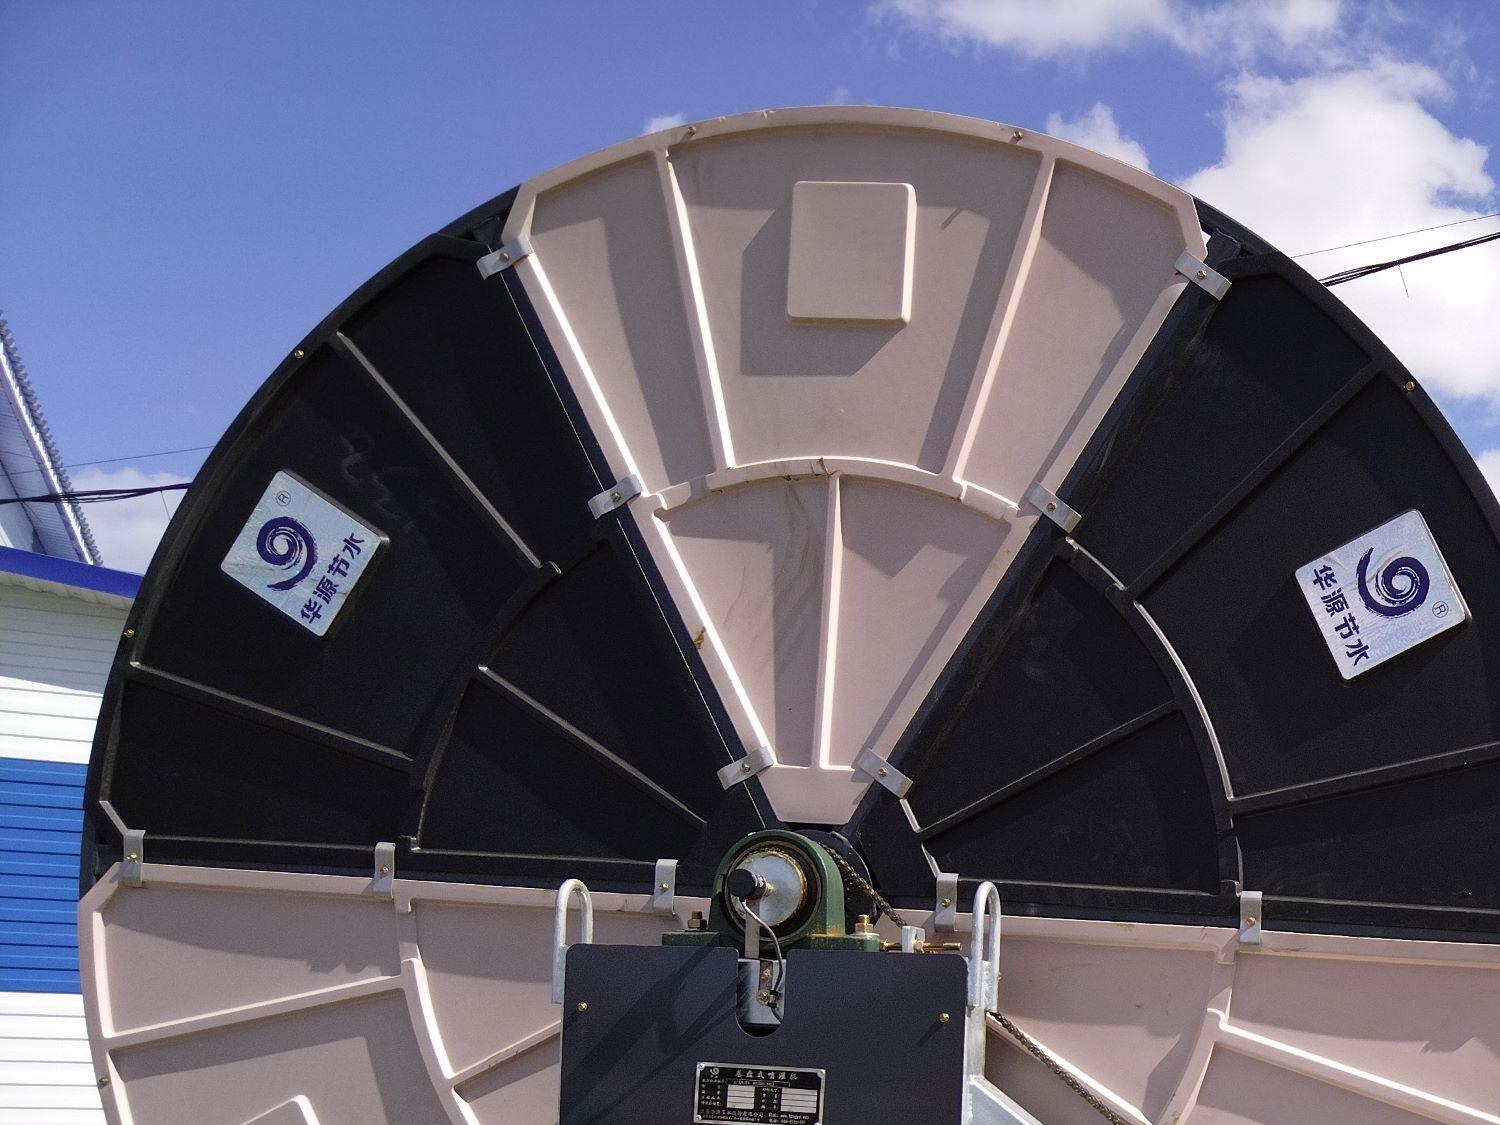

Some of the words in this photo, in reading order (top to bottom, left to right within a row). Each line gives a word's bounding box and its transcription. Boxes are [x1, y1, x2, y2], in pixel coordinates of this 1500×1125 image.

[300, 533, 365, 624] 华源节水
[1312, 565, 1371, 666] 华源节水
